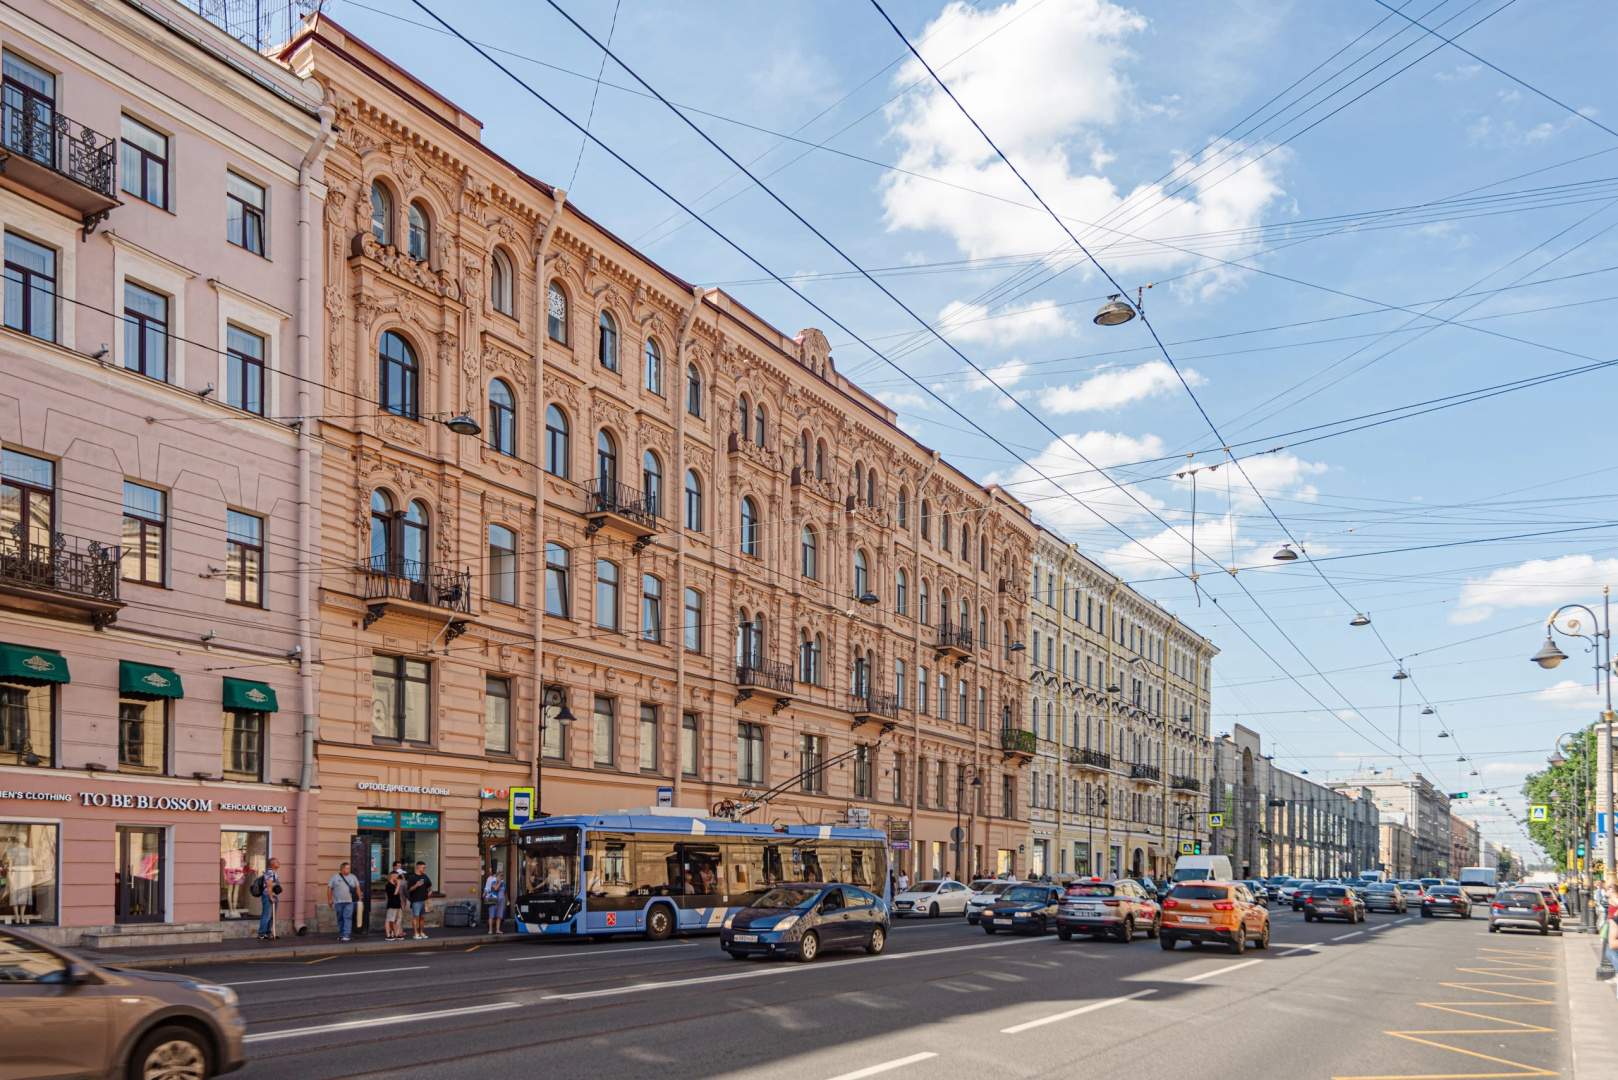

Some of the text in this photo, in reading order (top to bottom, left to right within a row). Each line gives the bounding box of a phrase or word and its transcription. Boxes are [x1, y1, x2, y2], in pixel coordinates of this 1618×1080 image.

[357, 781, 450, 796] ОРТОПЕДИЧЕСКИЕ САЛОНЫ
[25, 791, 72, 802] CLOTHING
[80, 792, 213, 812] TO BE BLOSSOM
[219, 802, 288, 813] ЖЕНСКАЯ ОДЕЖДА
[526, 835, 532, 845] 12
